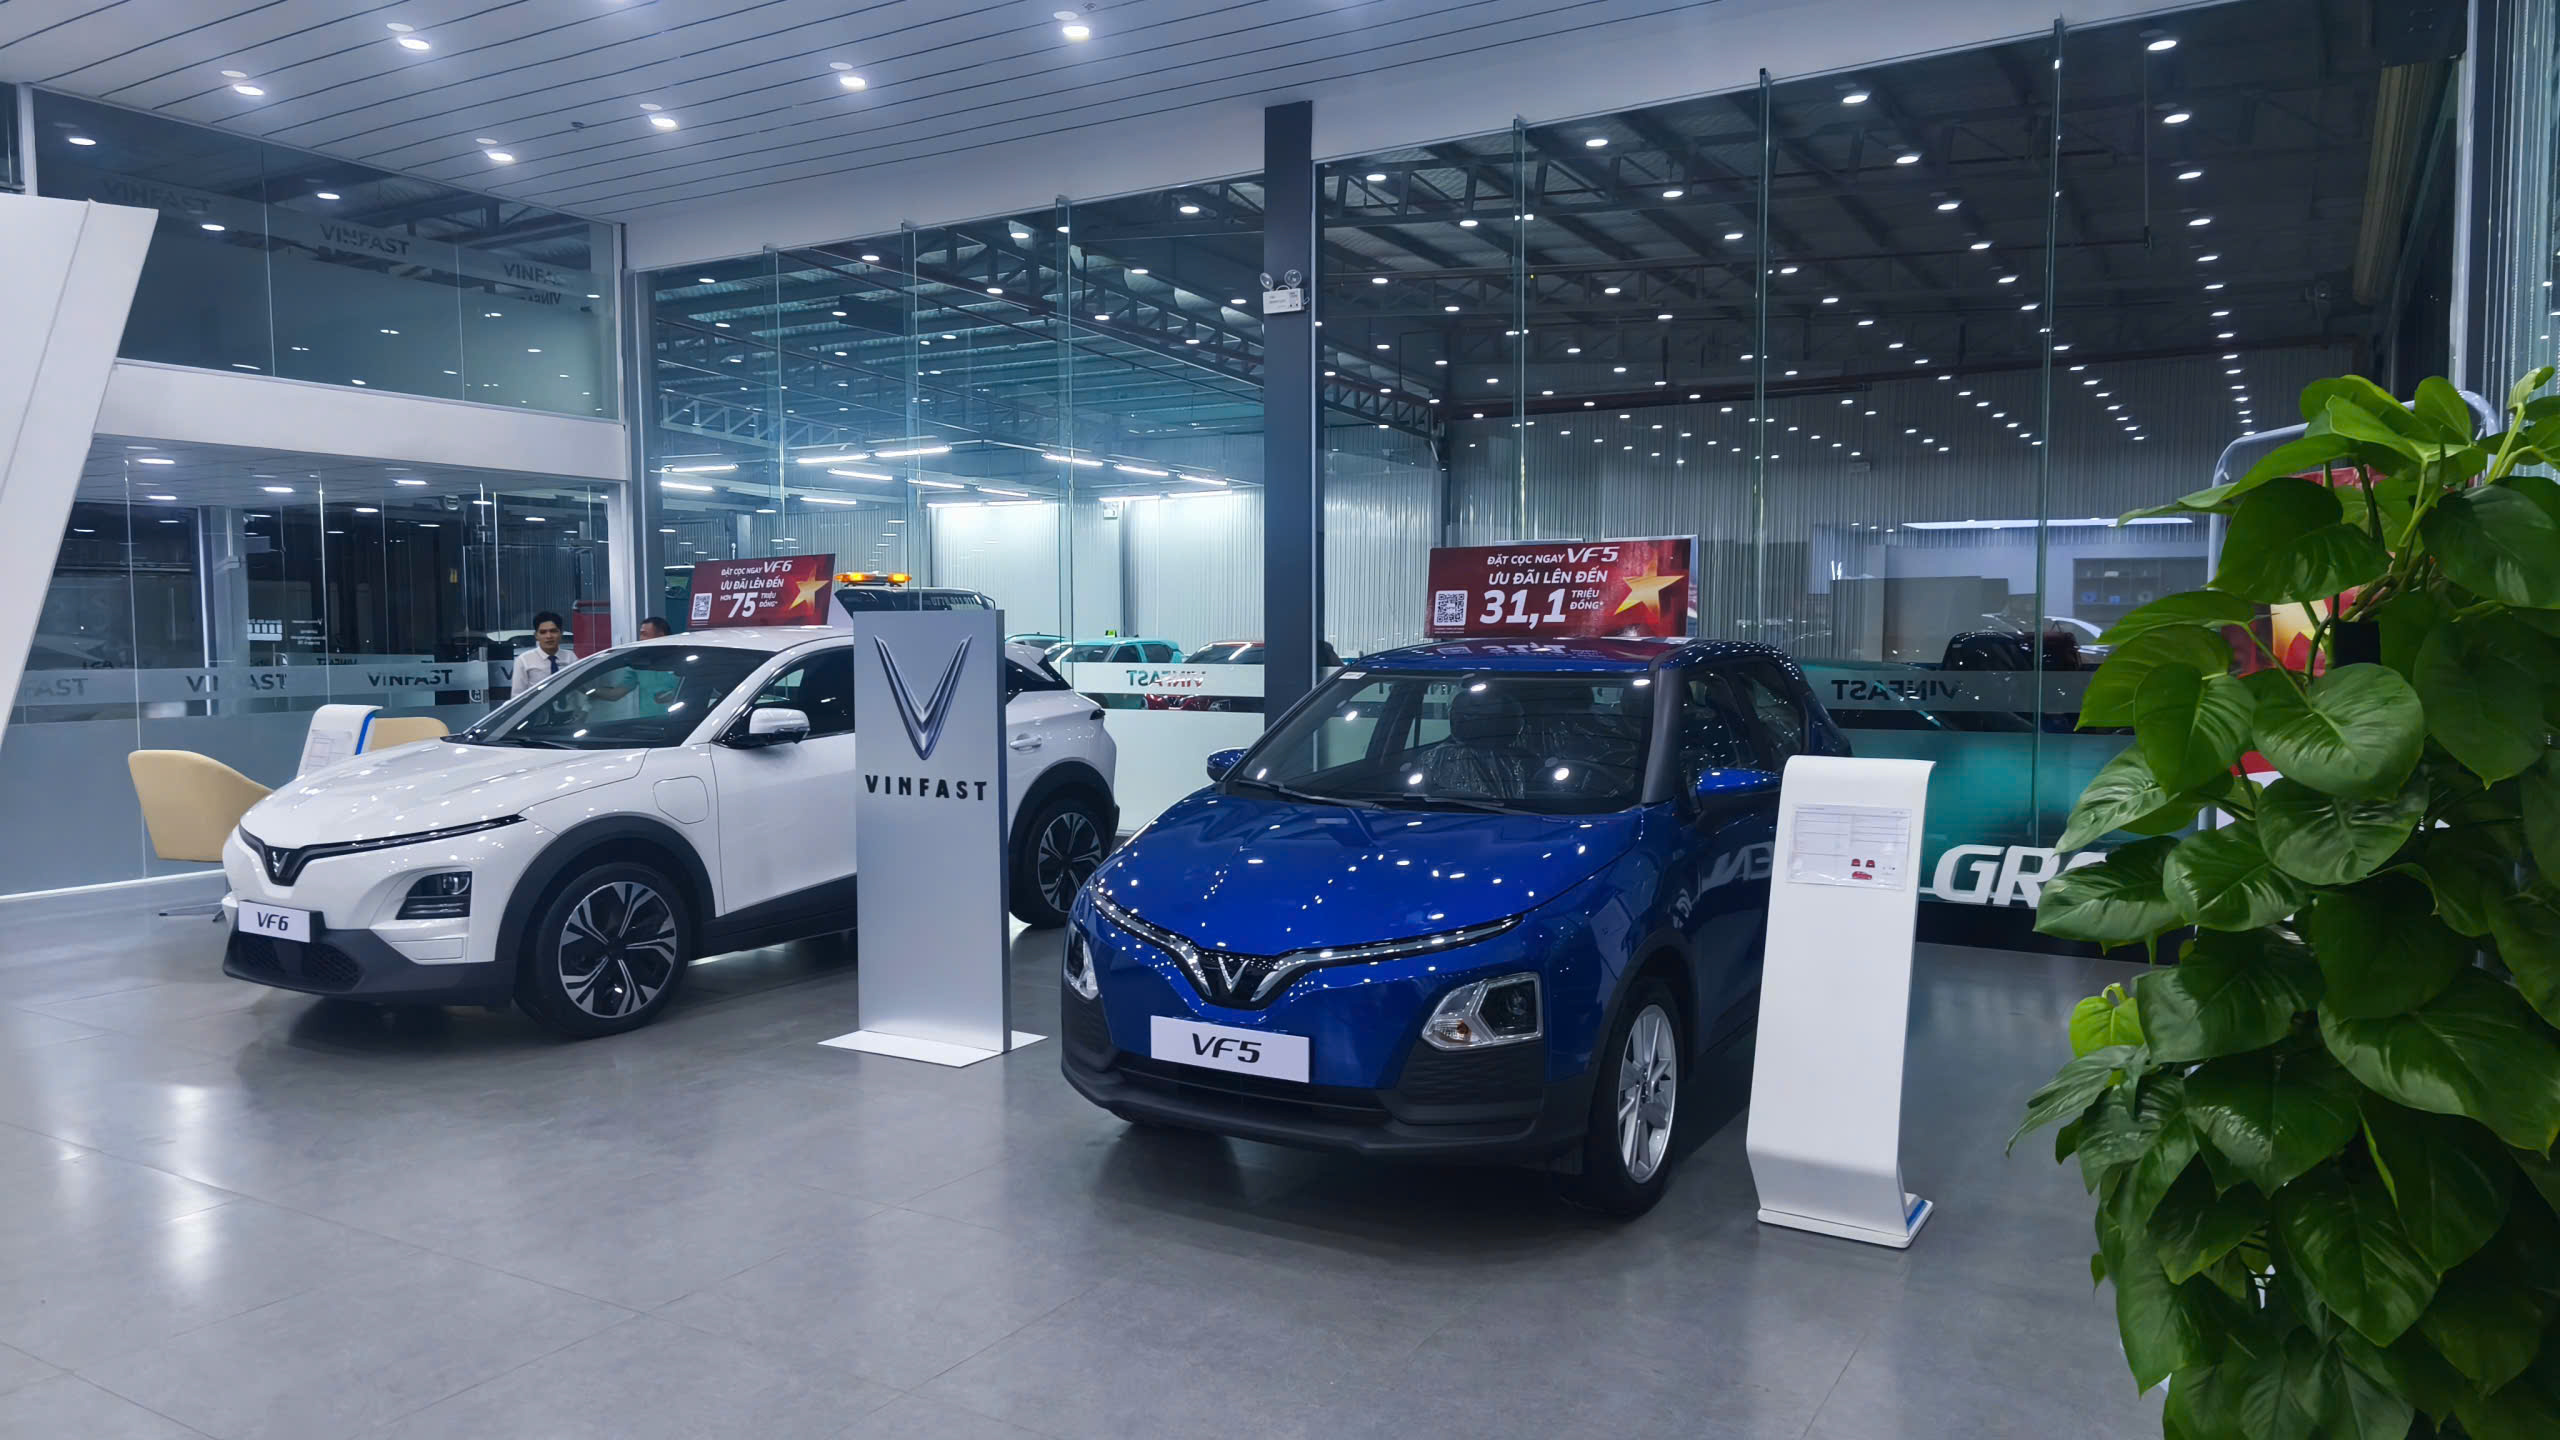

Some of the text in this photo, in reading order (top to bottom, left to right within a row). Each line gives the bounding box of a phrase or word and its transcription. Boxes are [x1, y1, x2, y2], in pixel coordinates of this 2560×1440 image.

[1487, 546, 1620, 567] ĐẶT CỌC NGAY VF5
[721, 560, 793, 577] ĐẶT CỌC NGAY VF6
[1488, 565, 1608, 585] ƯU ĐÃI LÊN ĐẾN
[721, 575, 785, 590] ƯU ĐÃI LÊN ĐẾN
[1571, 587, 1600, 600] TRIỆU
[728, 592, 758, 618] 75
[1480, 588, 1566, 630] 31,1
[865, 774, 987, 801] VINFAST
[1933, 844, 2107, 909] GR
[257, 911, 290, 931] VF6
[1192, 1032, 1262, 1064] VF5
